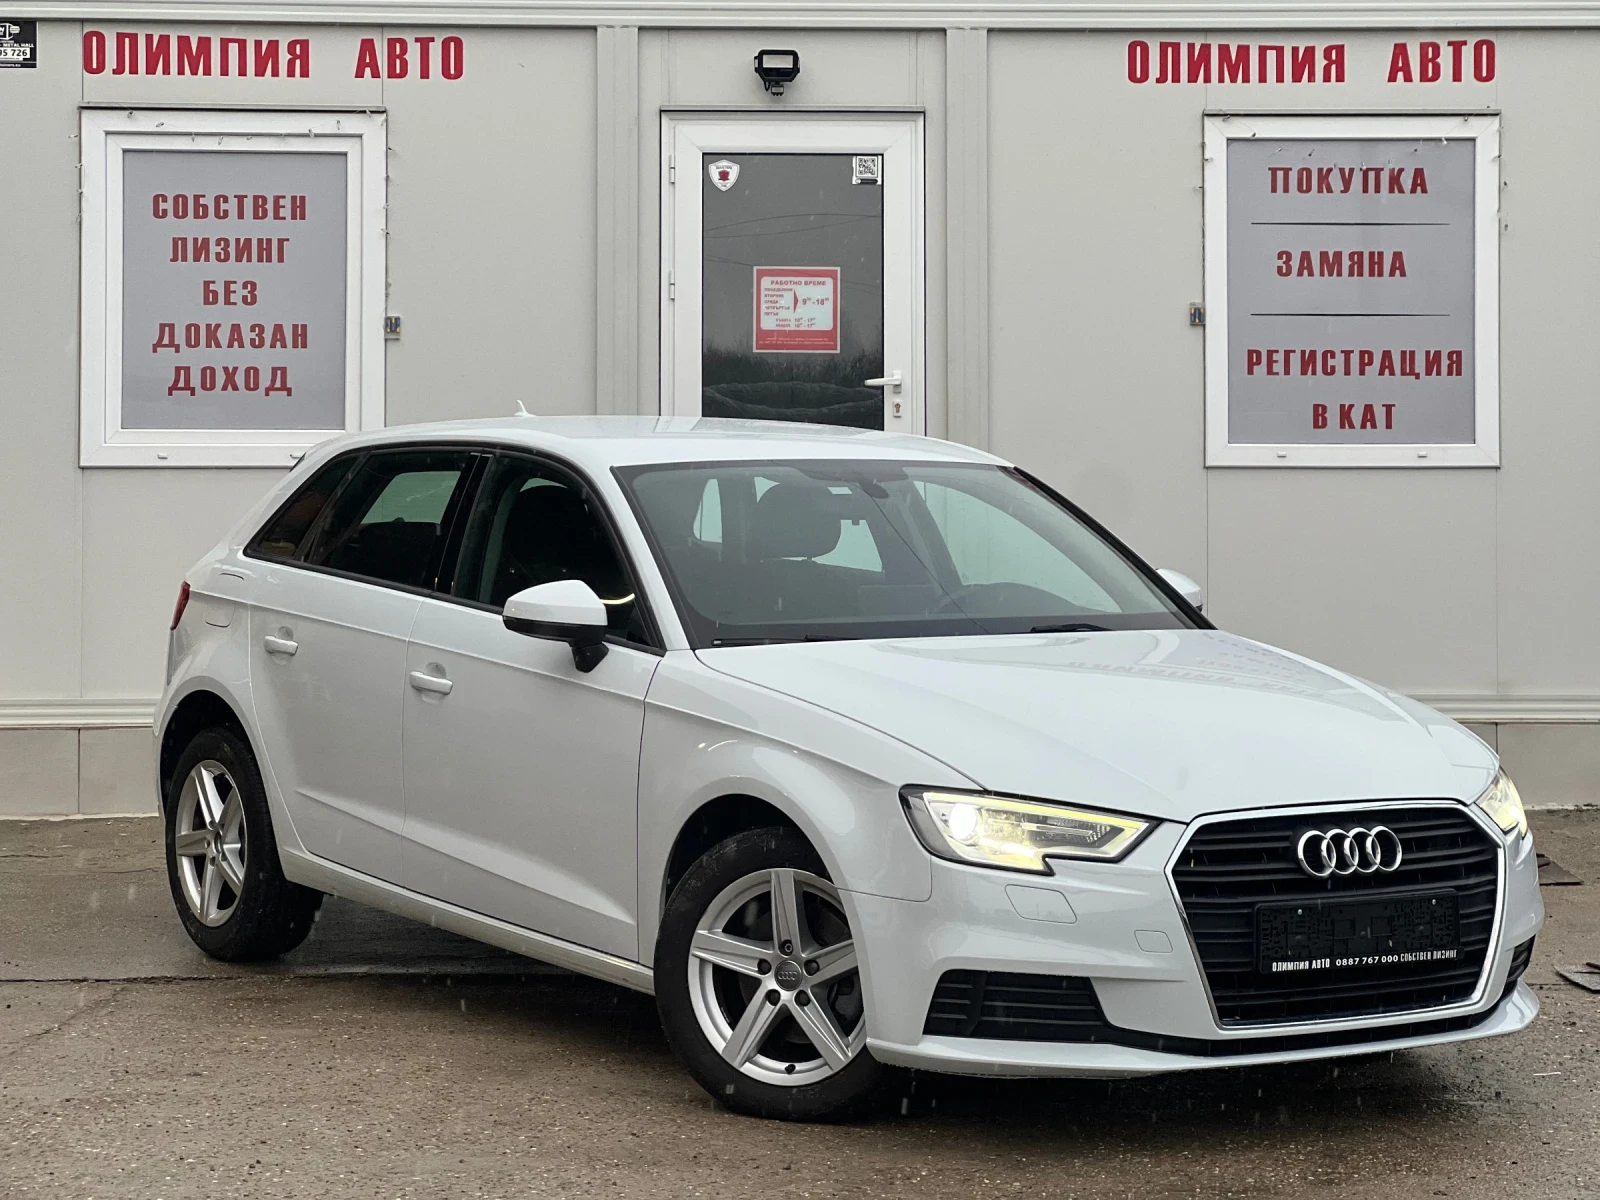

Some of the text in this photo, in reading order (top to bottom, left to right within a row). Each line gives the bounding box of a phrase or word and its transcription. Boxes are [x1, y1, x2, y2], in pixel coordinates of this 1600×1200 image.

[82, 30, 465, 80] ОЛИМПИЯ АВТО
[1127, 39, 1497, 84] ОЛИМПИЯ АВТО
[1268, 167, 1429, 194] ПОКУПКА
[152, 193, 307, 220] СОБСТВЕН
[169, 237, 291, 263] ЛИЗИНГ
[1276, 250, 1408, 278] ЗАМЯНА
[202, 280, 258, 306] БЕЗ
[152, 323, 308, 353] ДОКАЗАН
[1247, 349, 1464, 380] РЕГИСТРАЦИЯ
[167, 366, 293, 396] ДОХОД
[1312, 403, 1396, 430] В КАТ
[1272, 961, 1310, 972] ОЛИМПИЯ
[1312, 958, 1331, 969] АВТО
[1335, 958, 1360, 967] 0887
[1362, 956, 1379, 964] 767
[1381, 955, 1399, 963] 000
